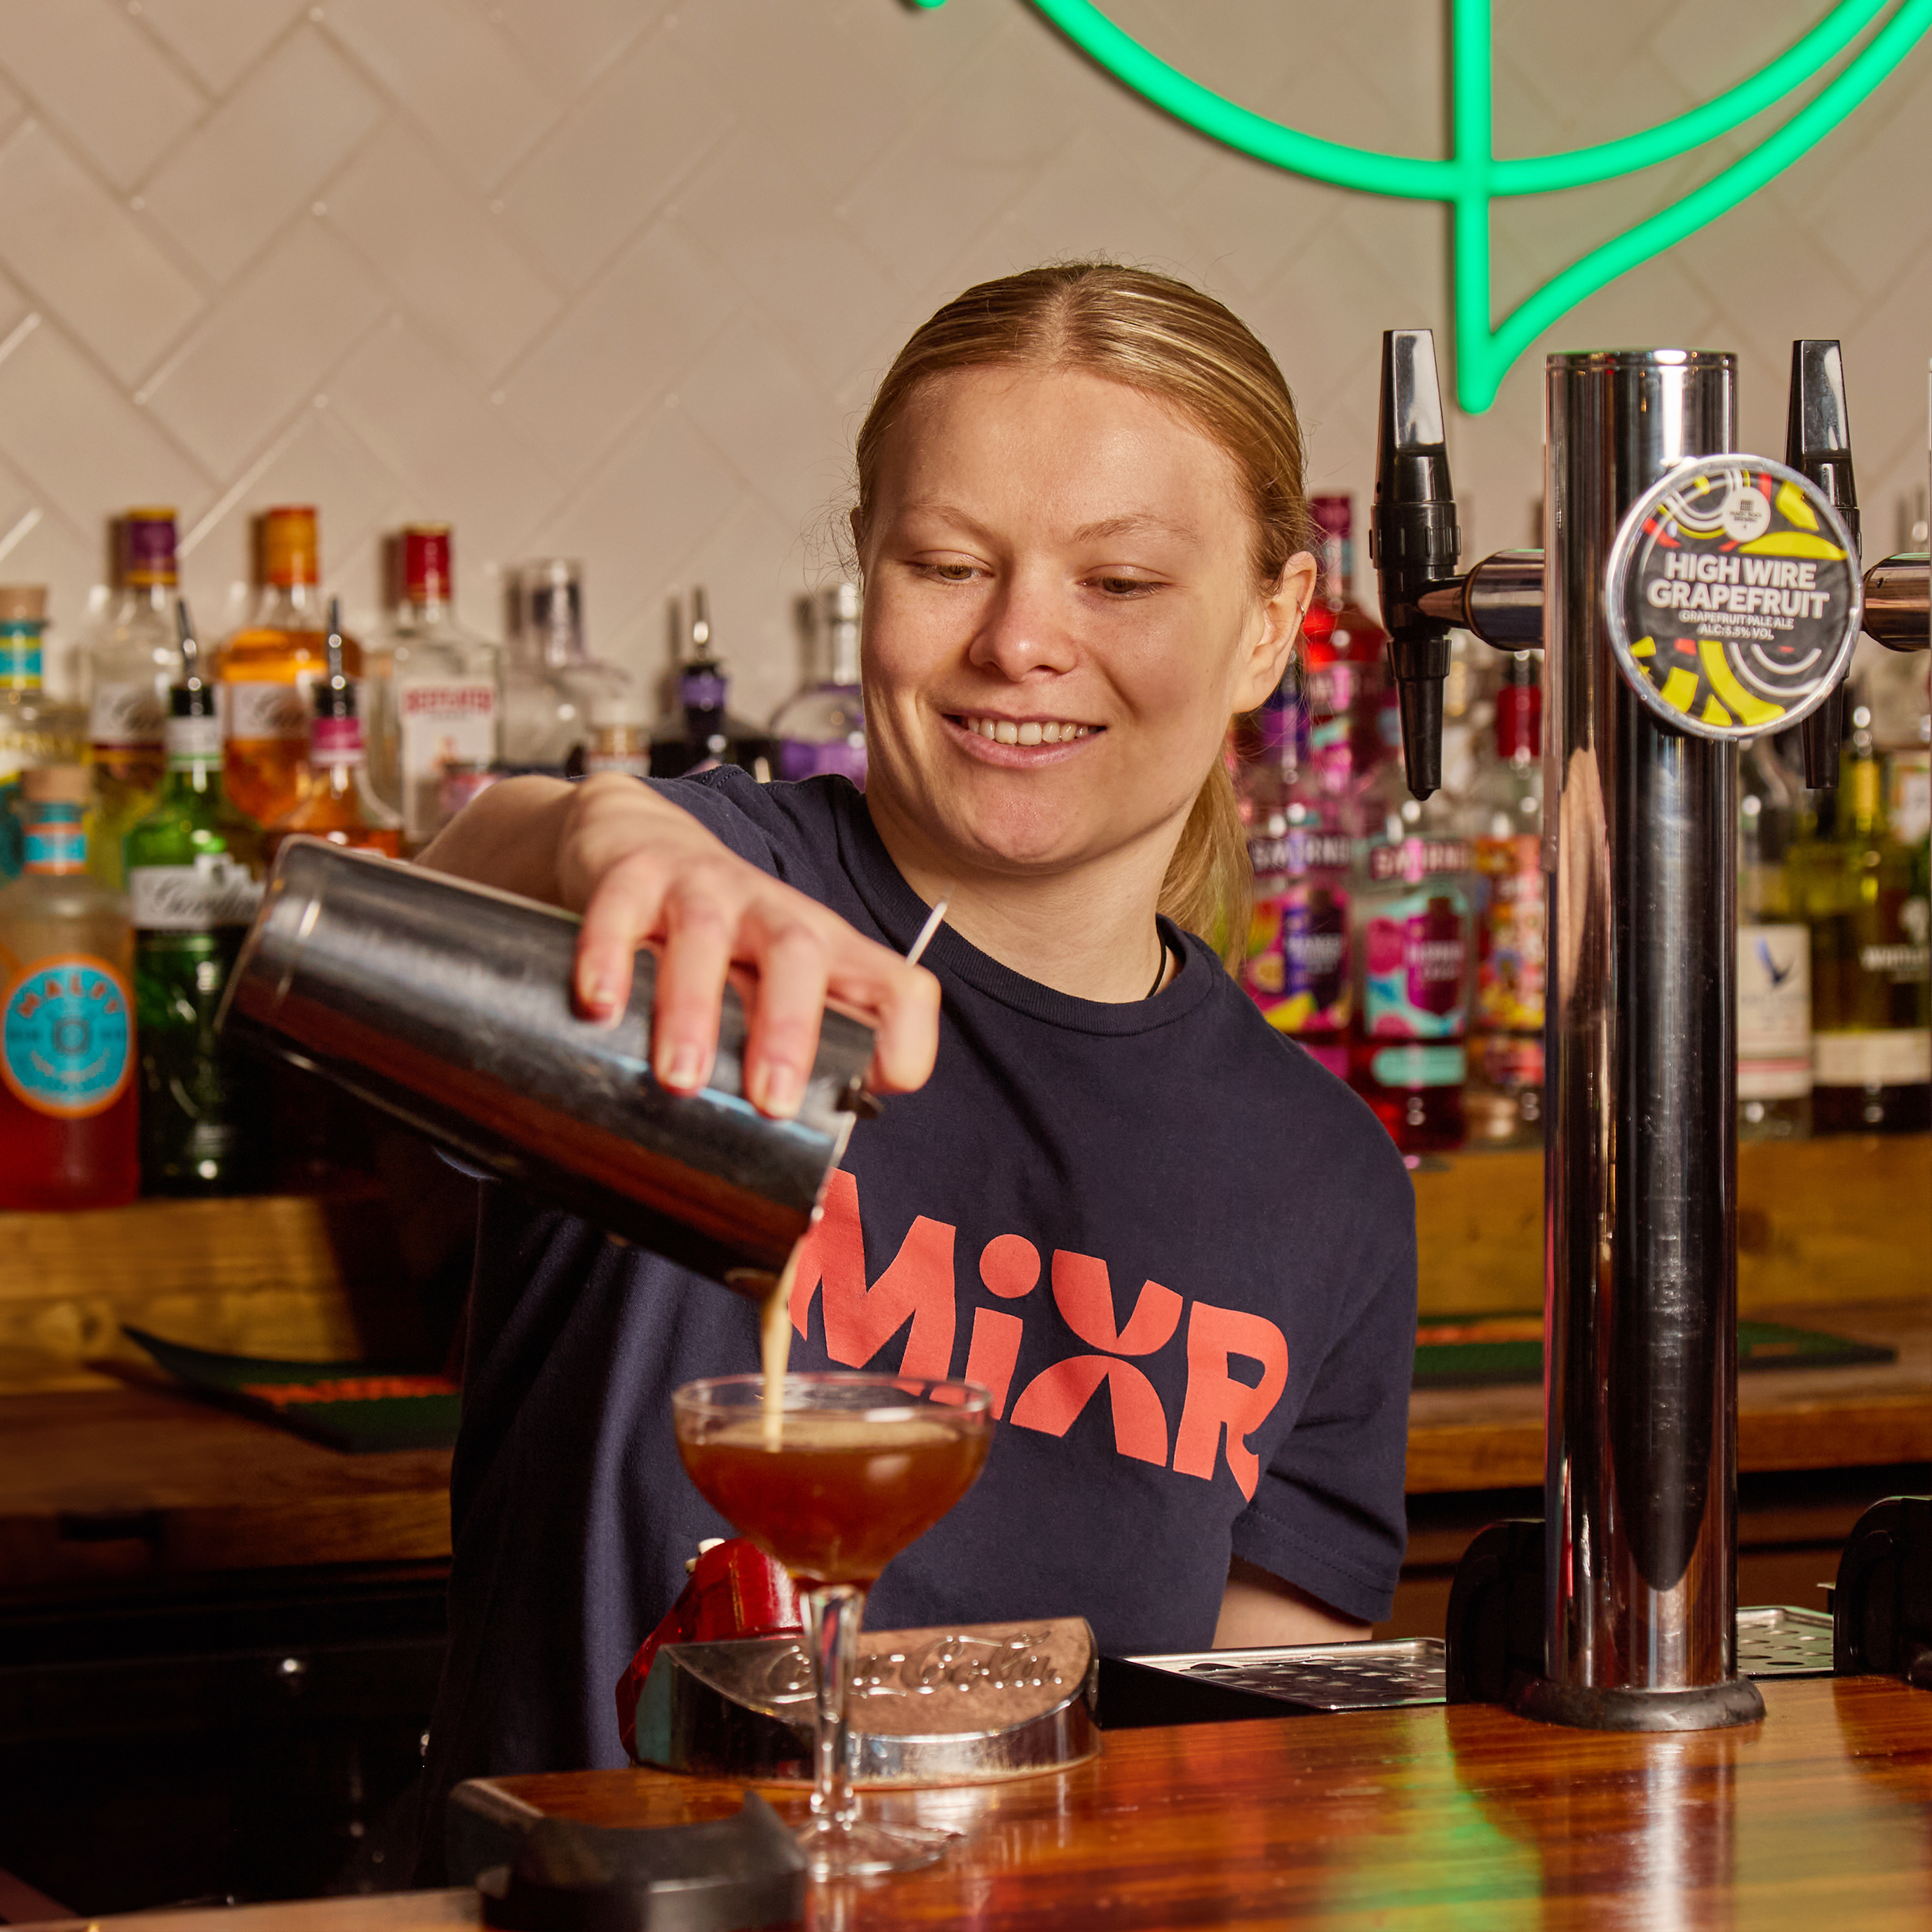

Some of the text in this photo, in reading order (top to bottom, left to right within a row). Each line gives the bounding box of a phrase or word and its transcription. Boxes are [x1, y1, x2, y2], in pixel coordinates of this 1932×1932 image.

[1664, 552, 1817, 590] HIGH WIRE
[1647, 578, 1830, 619] GRAPEFRUIT
[1679, 609, 1795, 630] GRAPEFRUIT PALE ALE
[1752, 627, 1775, 640] VOL
